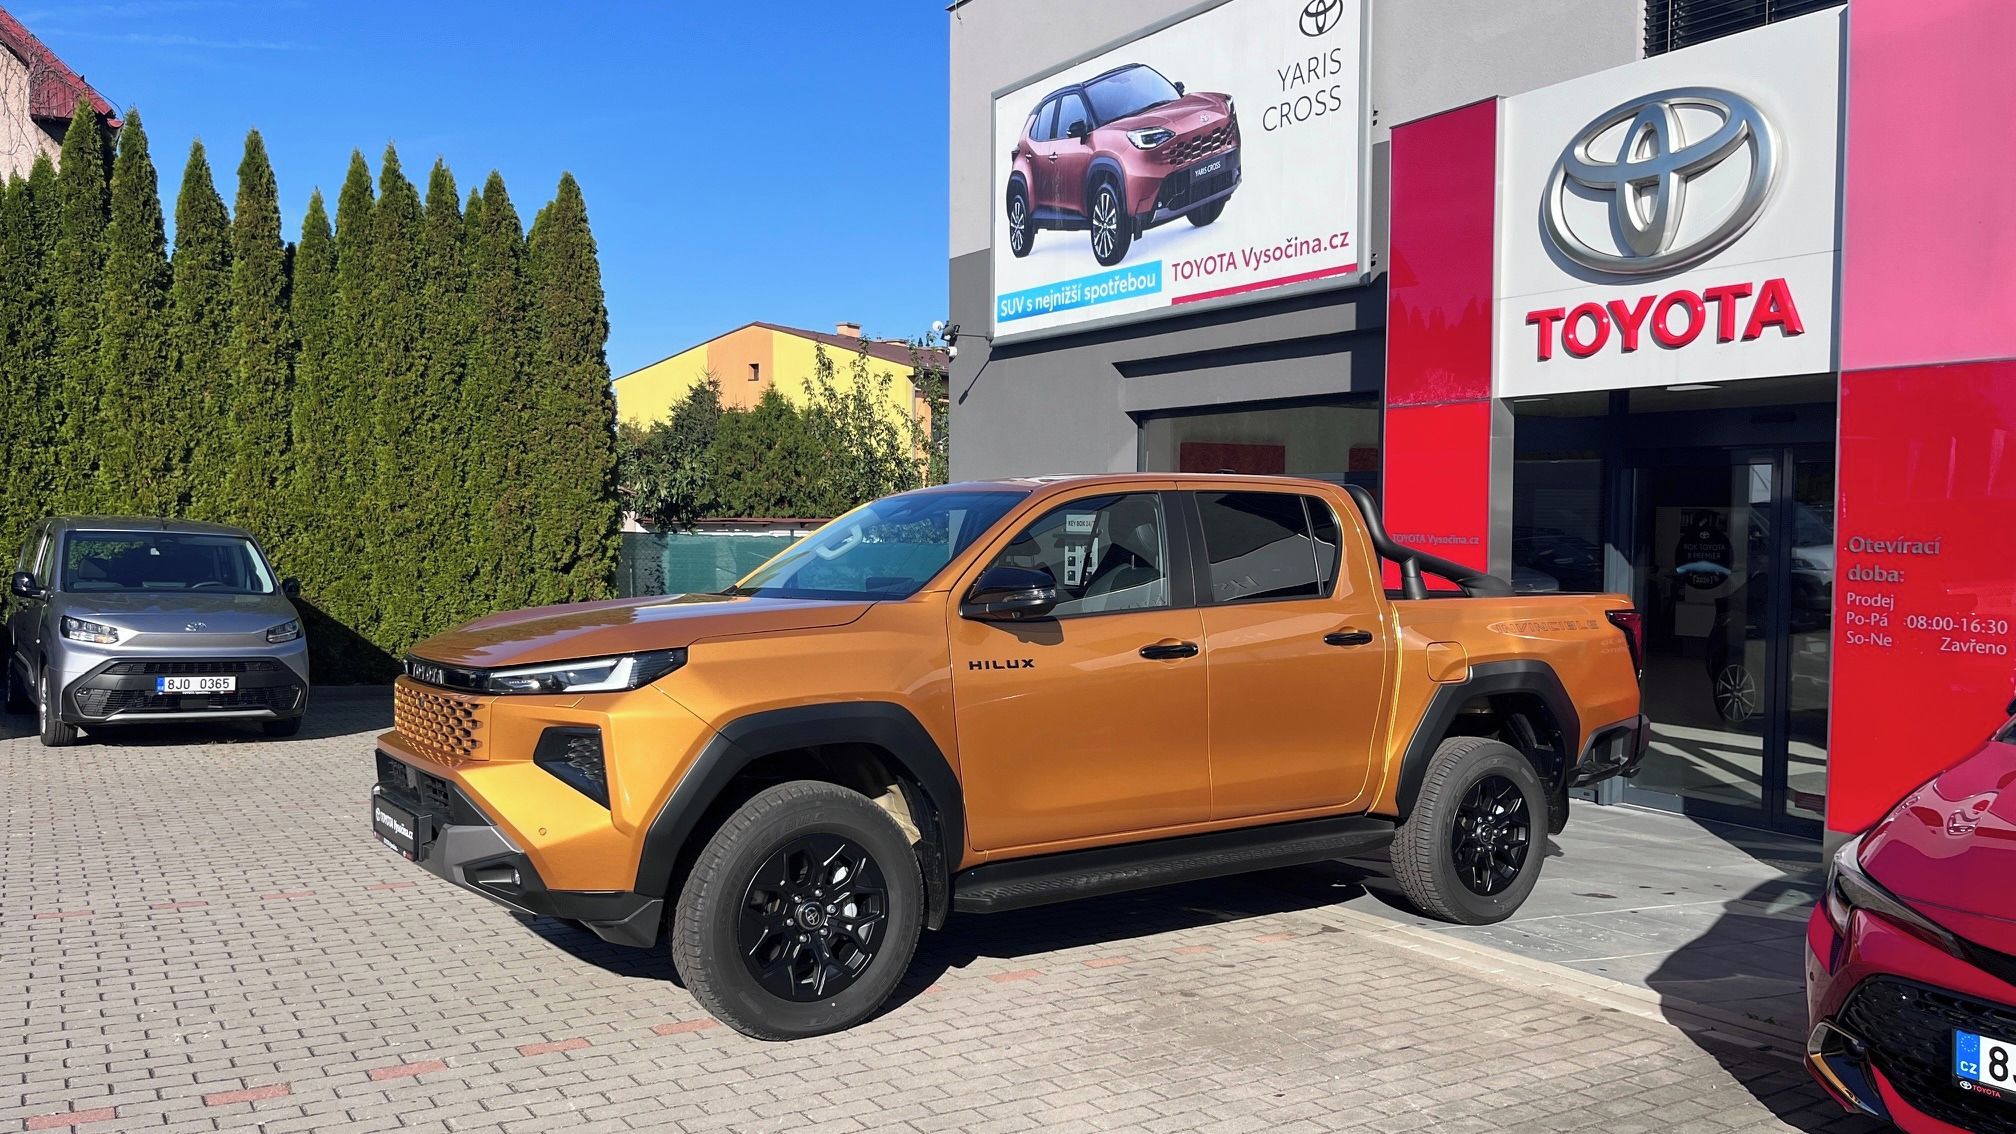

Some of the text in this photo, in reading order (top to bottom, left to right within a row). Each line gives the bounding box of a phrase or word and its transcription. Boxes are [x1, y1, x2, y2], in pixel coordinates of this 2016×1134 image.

[1277, 47, 1342, 92] YARIS
[1262, 84, 1342, 132] CROSS
[1195, 161, 1221, 176] YARIS CROSS
[1171, 231, 1350, 282] TOYOTA Vysočina.cz
[1000, 272, 1156, 317] SUV s nejnižší spotřebou
[1525, 277, 1805, 362] TOYOTA
[1392, 533, 1425, 544] TOYOTA
[1848, 535, 1942, 555] Otevírací
[1847, 564, 1905, 583] doba:
[1847, 592, 1894, 611] Prodej
[1846, 611, 2008, 635] Po-Pá 08:00-16:30
[1847, 630, 2007, 655] So-Ne Zavřeno
[968, 658, 1035, 671] HILUX
[200, 678, 230, 690] 0365
[1960, 1060, 1978, 1075] CZ
[1989, 1046, 2016, 1085] 8
[1972, 1085, 2001, 1098] TOYOTA
